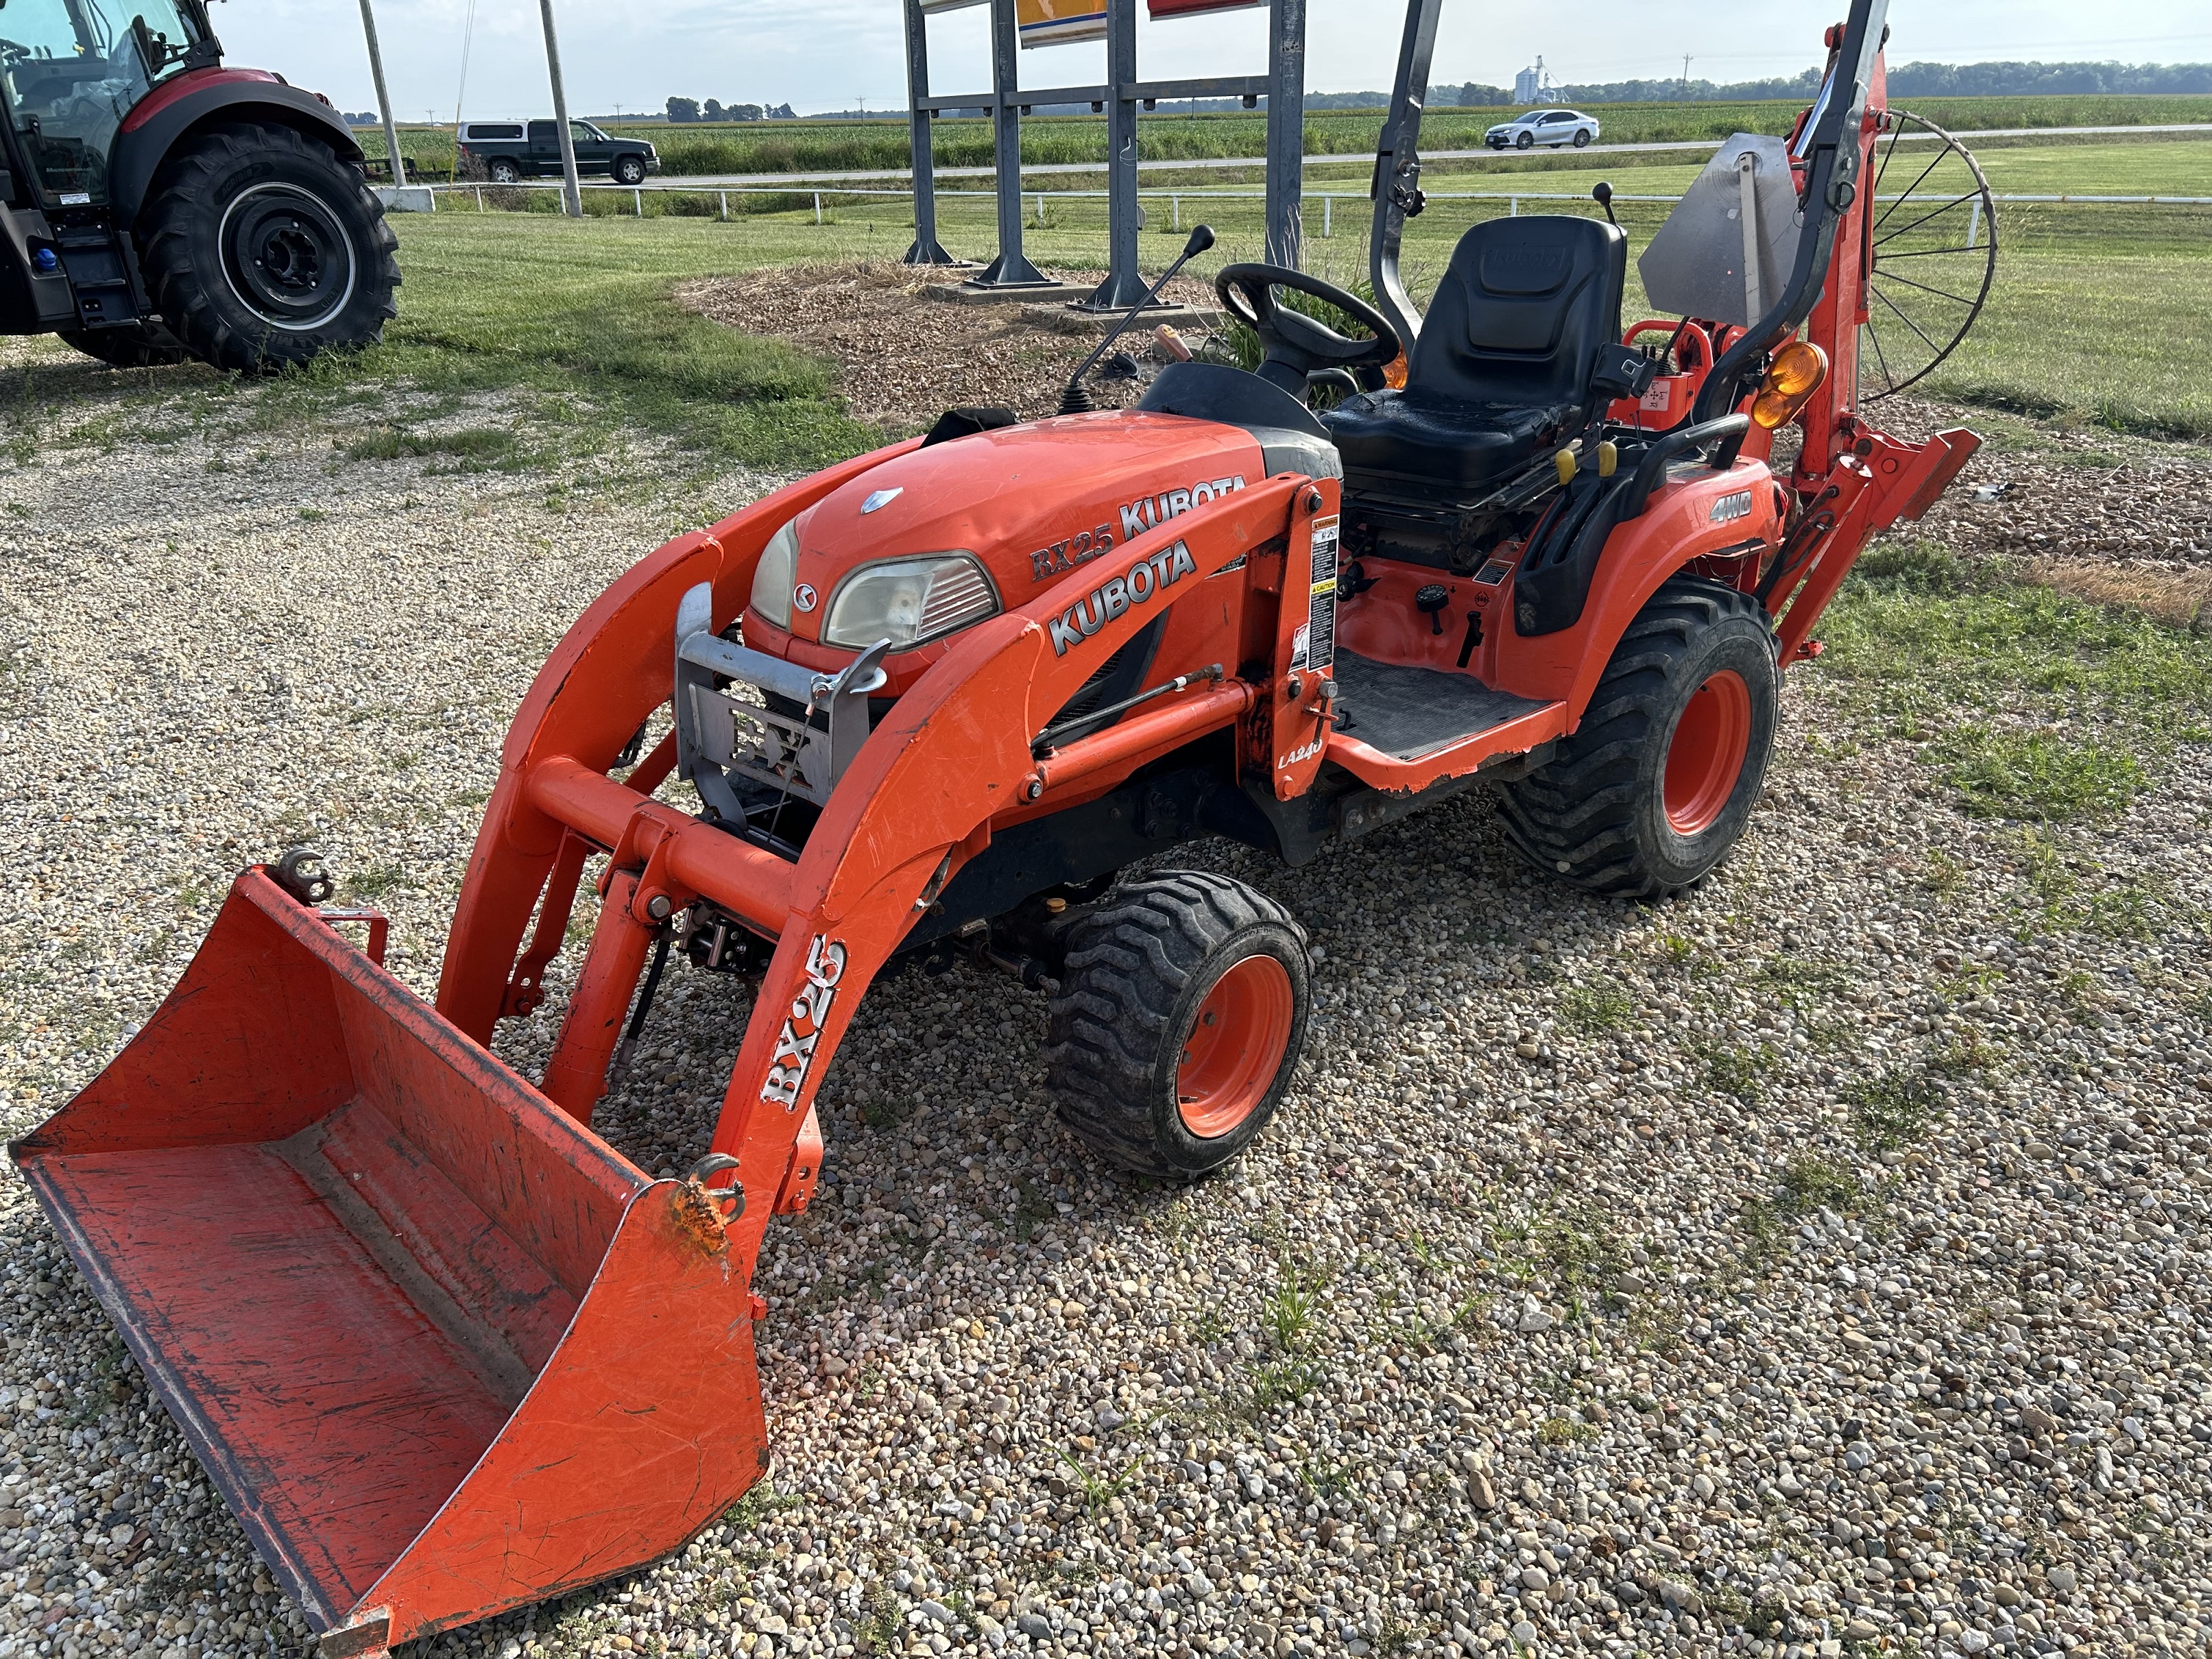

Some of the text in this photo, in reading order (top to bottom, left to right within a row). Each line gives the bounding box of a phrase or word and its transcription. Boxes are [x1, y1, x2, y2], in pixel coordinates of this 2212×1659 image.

[221, 163, 263, 197] AGRIBIB 2
[1317, 518, 1337, 528] WARNING
[1710, 490, 1751, 522] 4WD
[1029, 522, 1114, 582] BX25
[1048, 540, 1197, 657] KUBOTA
[1316, 581, 1336, 592] CAUTION
[729, 708, 813, 789] BX
[1277, 738, 1323, 770] LA240
[760, 934, 847, 1111] BX25
